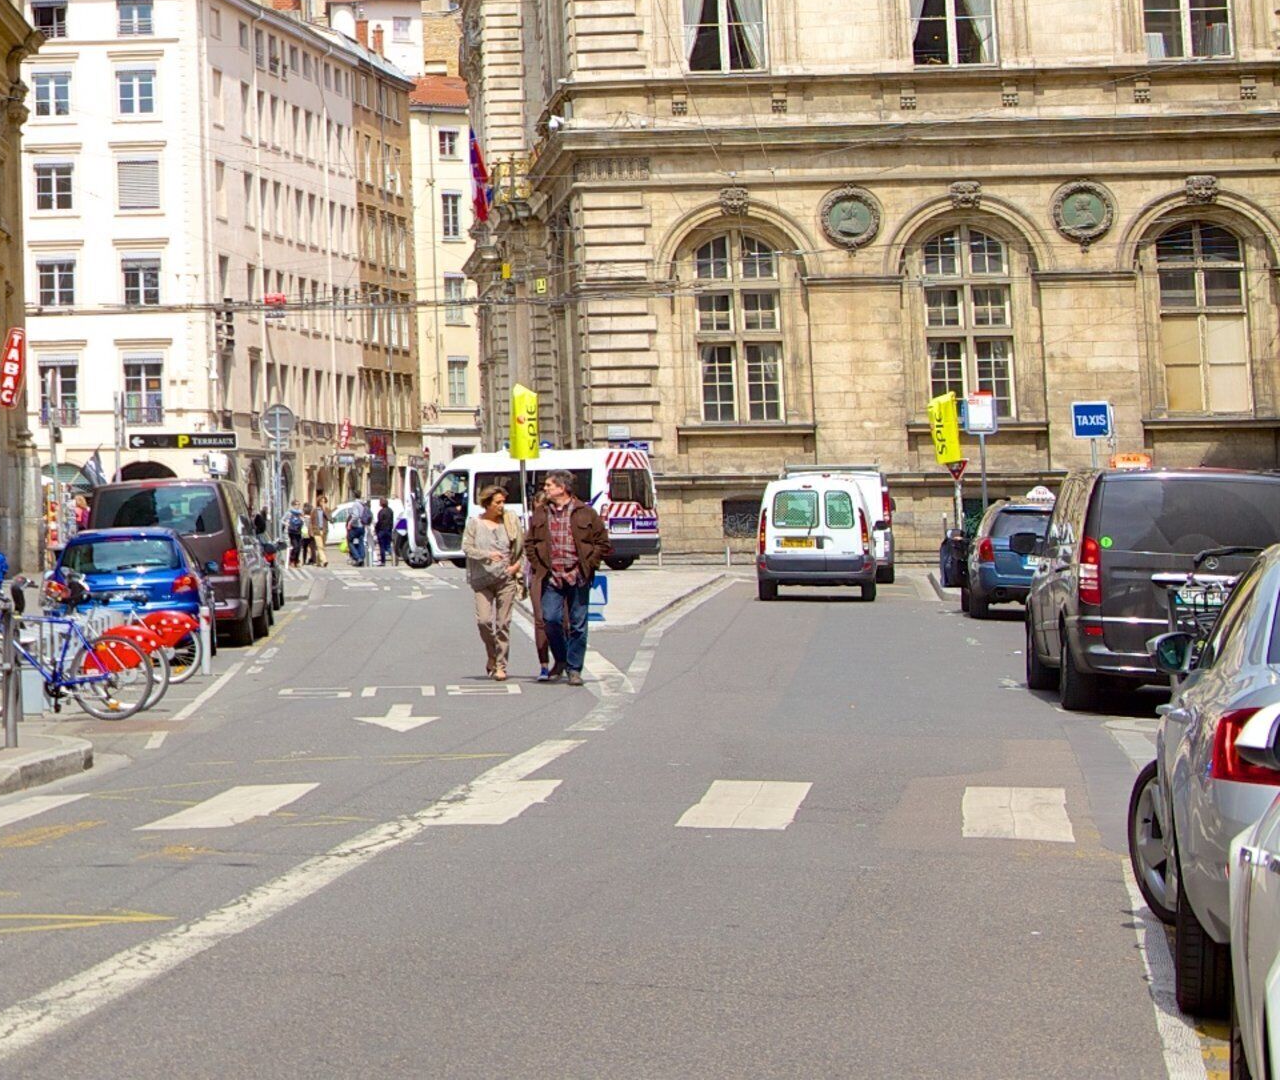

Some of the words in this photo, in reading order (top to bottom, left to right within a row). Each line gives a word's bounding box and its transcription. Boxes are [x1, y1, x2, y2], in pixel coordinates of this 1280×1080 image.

[1, 333, 22, 403] TABAC
[1075, 414, 1106, 427] TAXIS
[178, 435, 190, 449] P
[192, 436, 234, 446] TERREAUX
